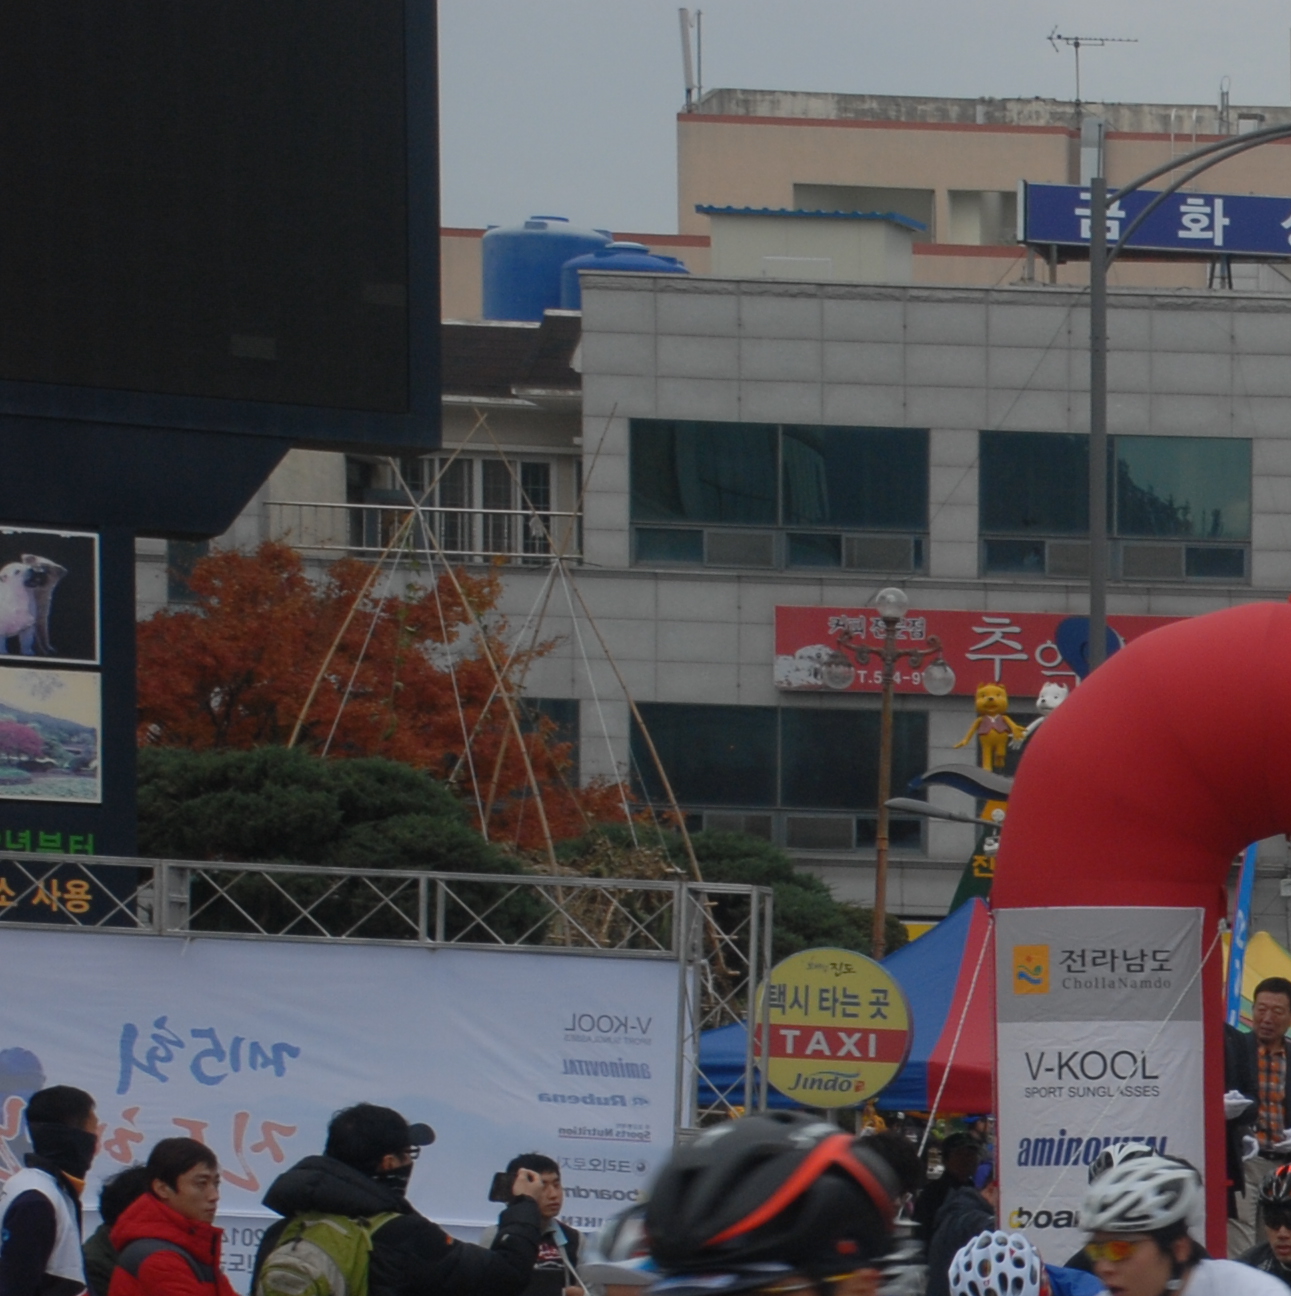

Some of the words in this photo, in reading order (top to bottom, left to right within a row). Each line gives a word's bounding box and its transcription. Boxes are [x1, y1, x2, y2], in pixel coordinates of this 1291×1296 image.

[31, 878, 92, 913] 사용
[1059, 948, 1173, 974] 전라남도
[1061, 976, 1172, 990] ChollaNamdo
[818, 986, 861, 1018] 타는
[868, 988, 890, 1019] 곳
[779, 1028, 877, 1058] TAXI
[1024, 1050, 1160, 1081] V-KOOL
[788, 1072, 853, 1092] Jindo
[1024, 1086, 1065, 1098] SPORT
